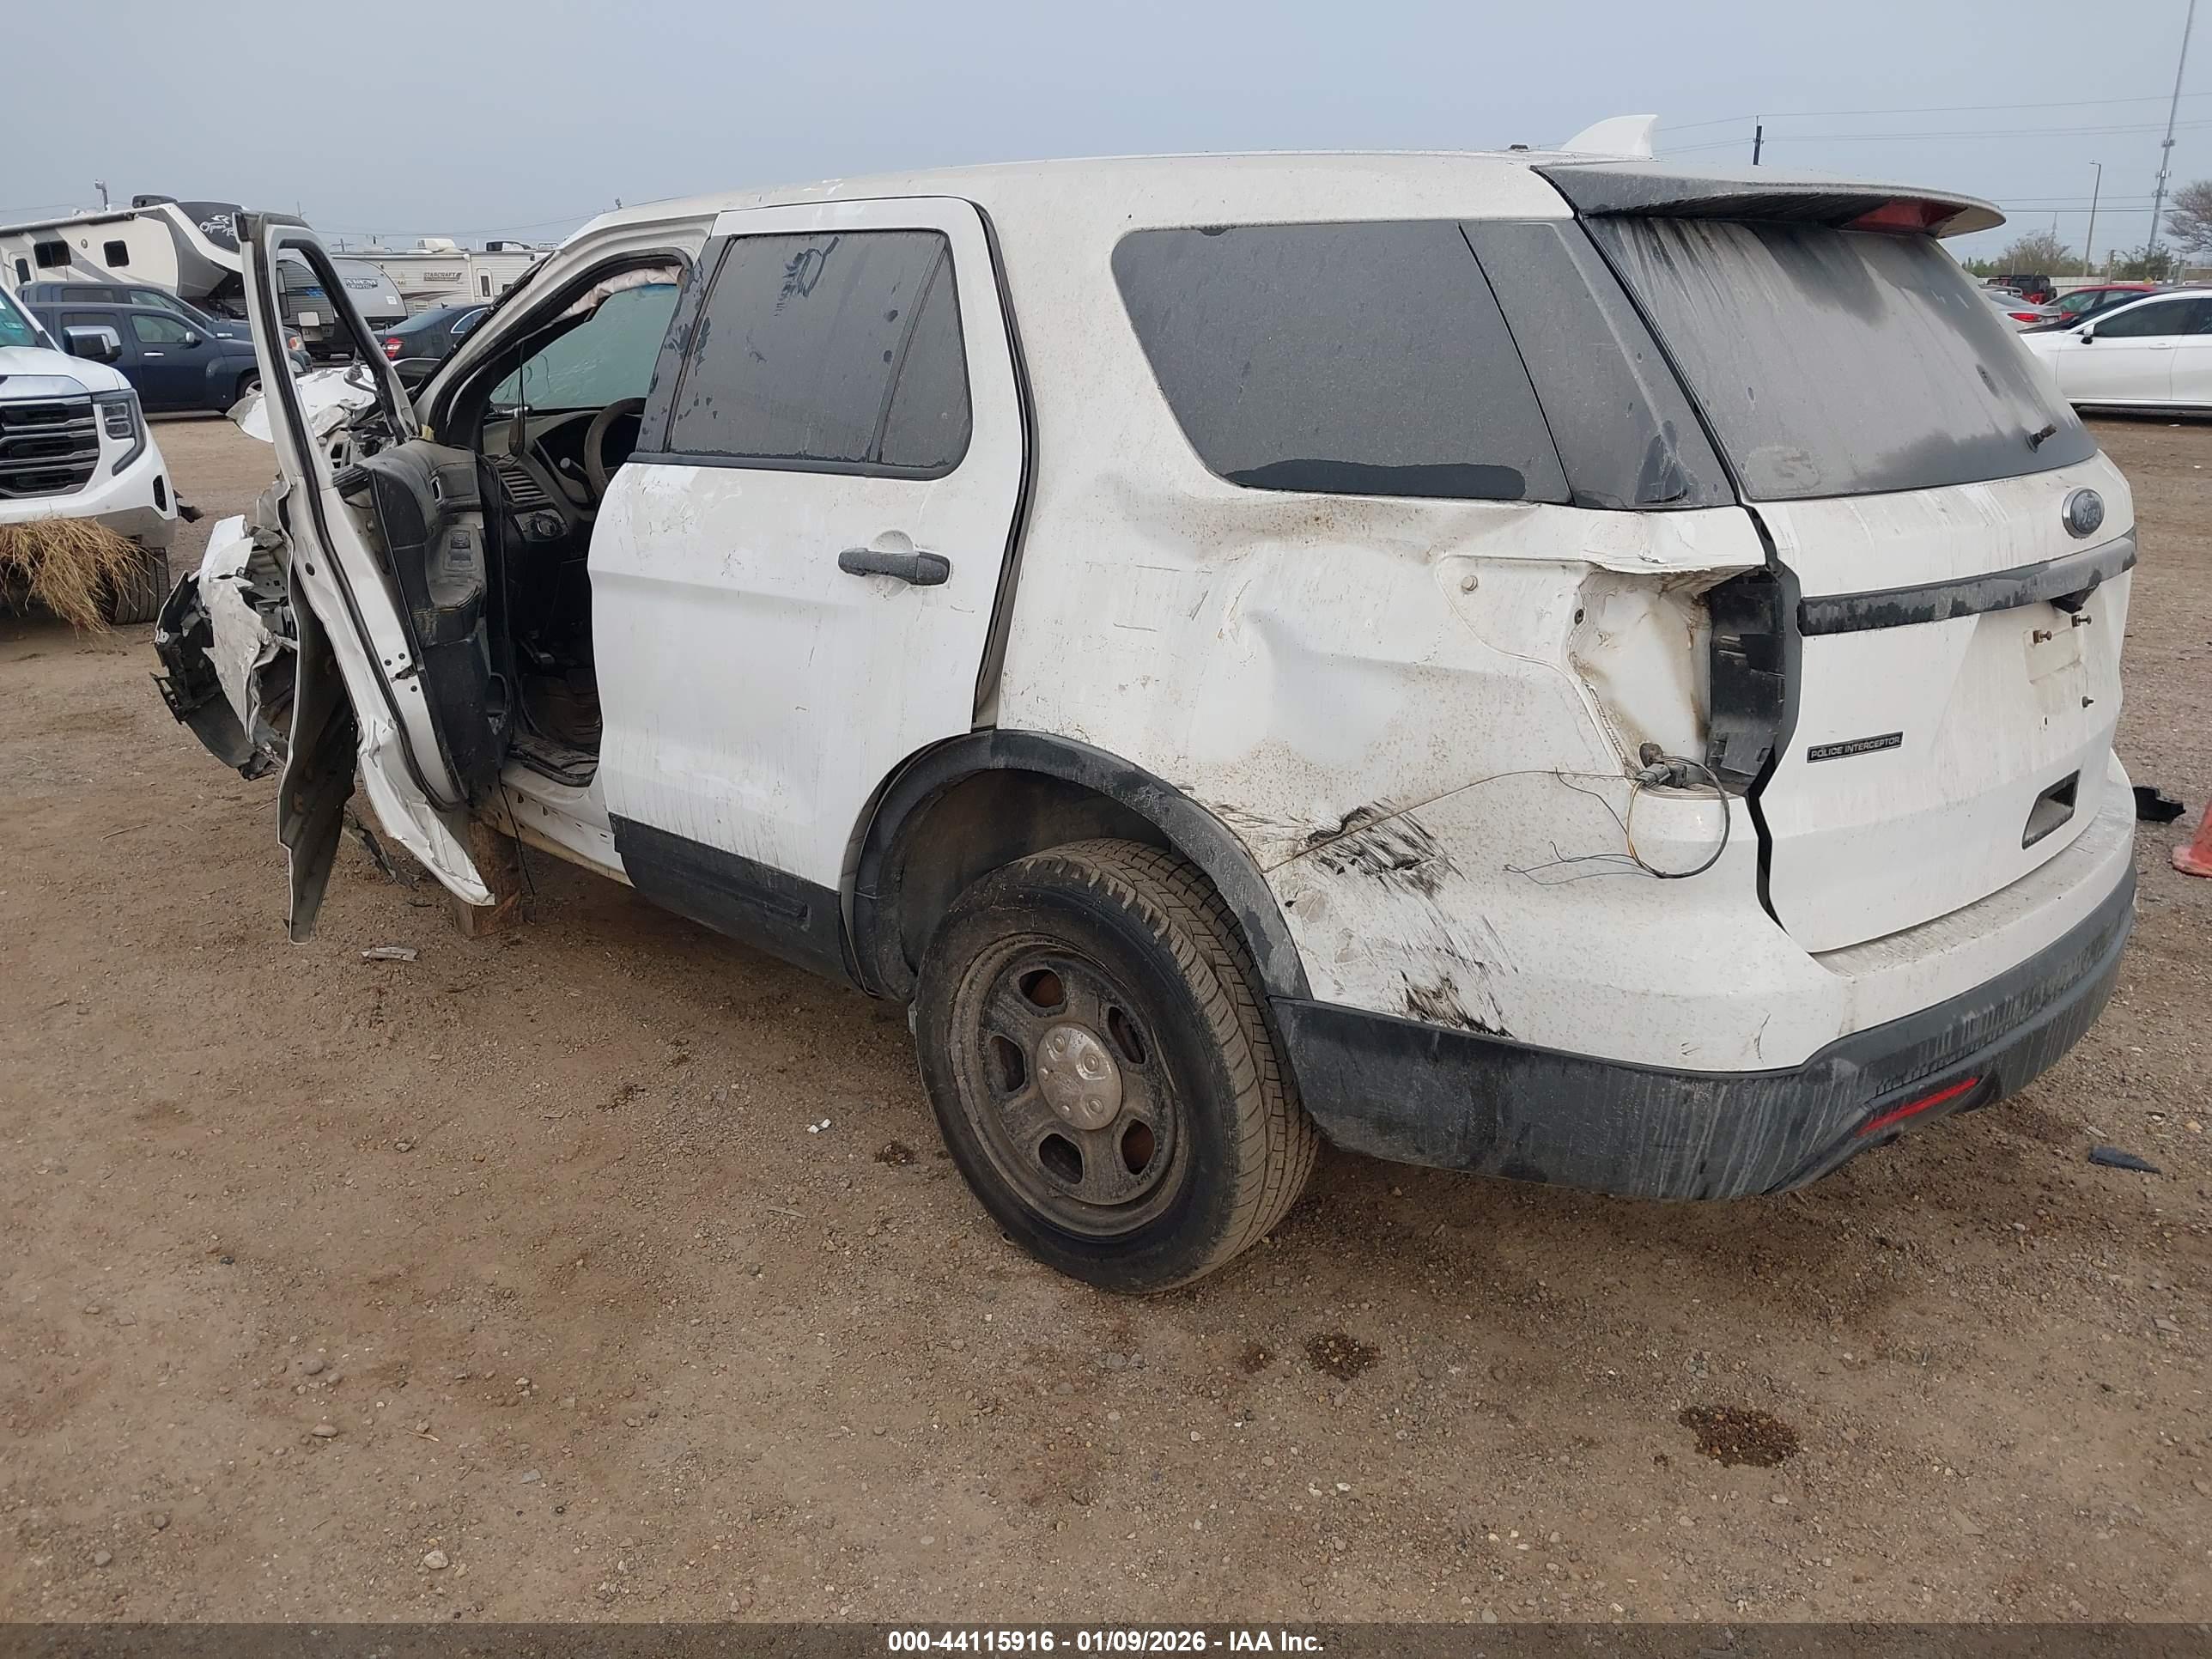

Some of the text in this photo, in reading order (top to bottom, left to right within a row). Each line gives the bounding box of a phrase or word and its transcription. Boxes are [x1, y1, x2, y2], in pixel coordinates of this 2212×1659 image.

[199, 221, 227, 234] Open
[1811, 736, 1901, 759] POLICE INTERCEPTOR
